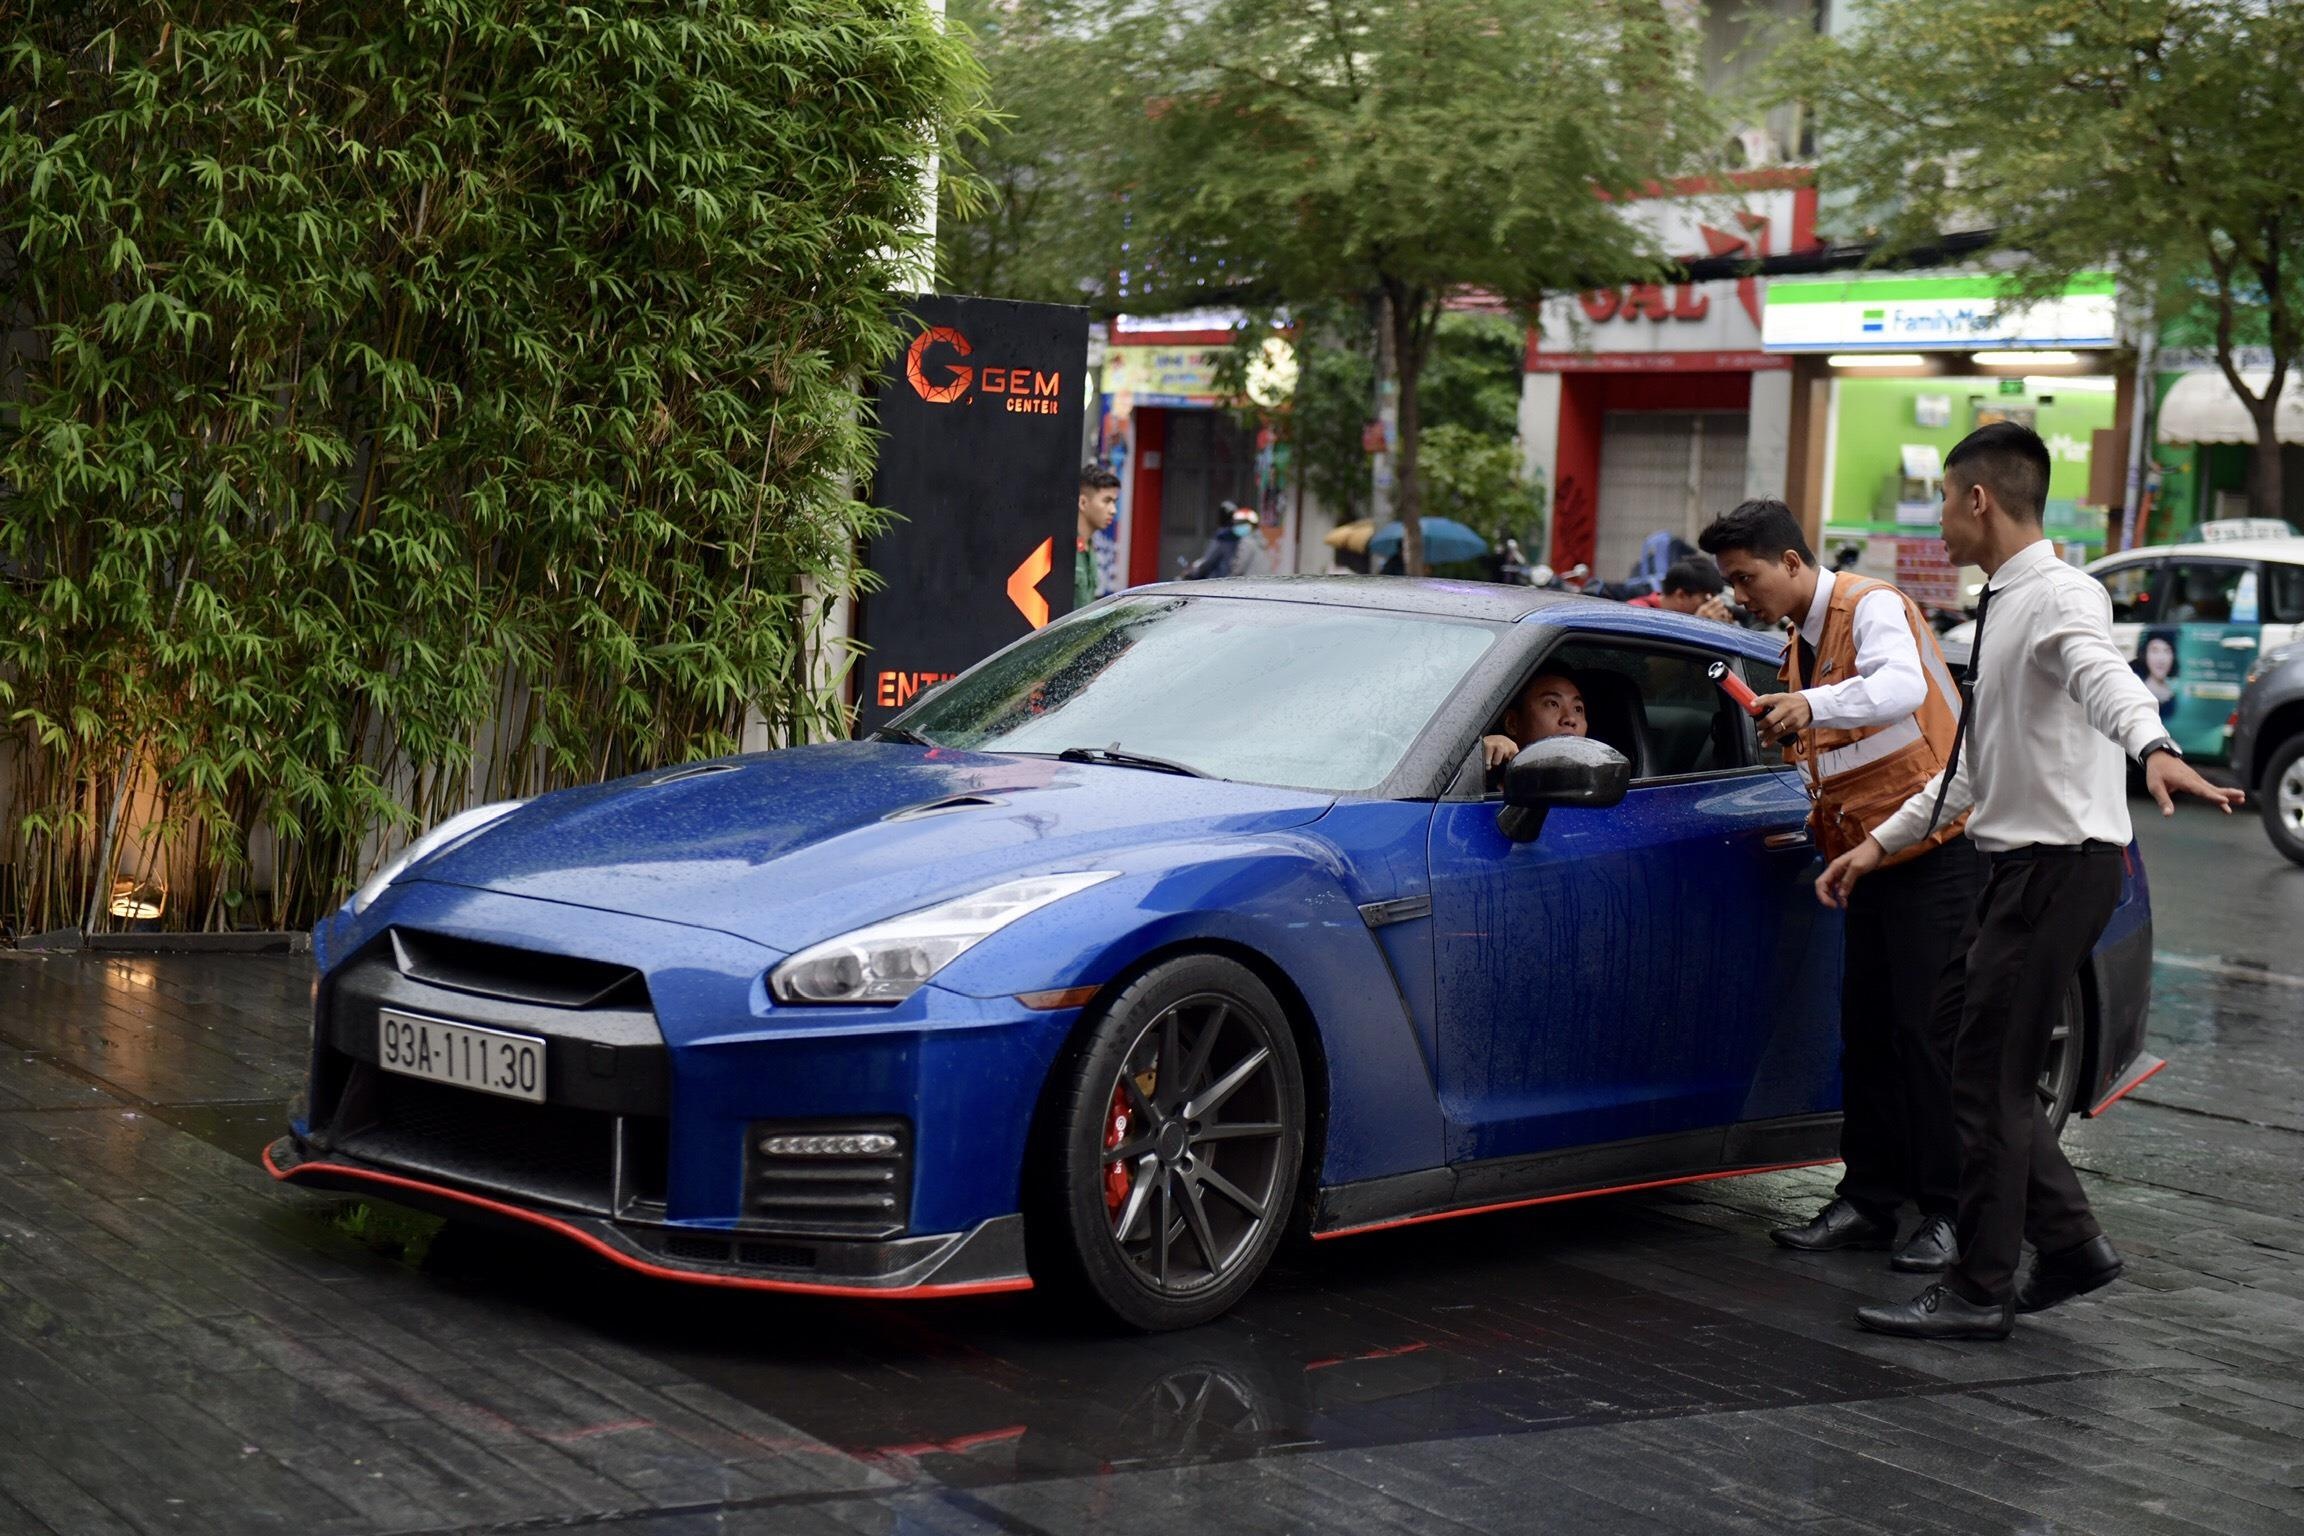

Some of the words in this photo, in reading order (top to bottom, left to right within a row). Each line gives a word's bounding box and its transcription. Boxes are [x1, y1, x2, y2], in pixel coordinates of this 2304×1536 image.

[982, 367, 1060, 396] GEM
[1006, 398, 1058, 414] CENTER
[385, 1020, 536, 1092] 93A-111.30
